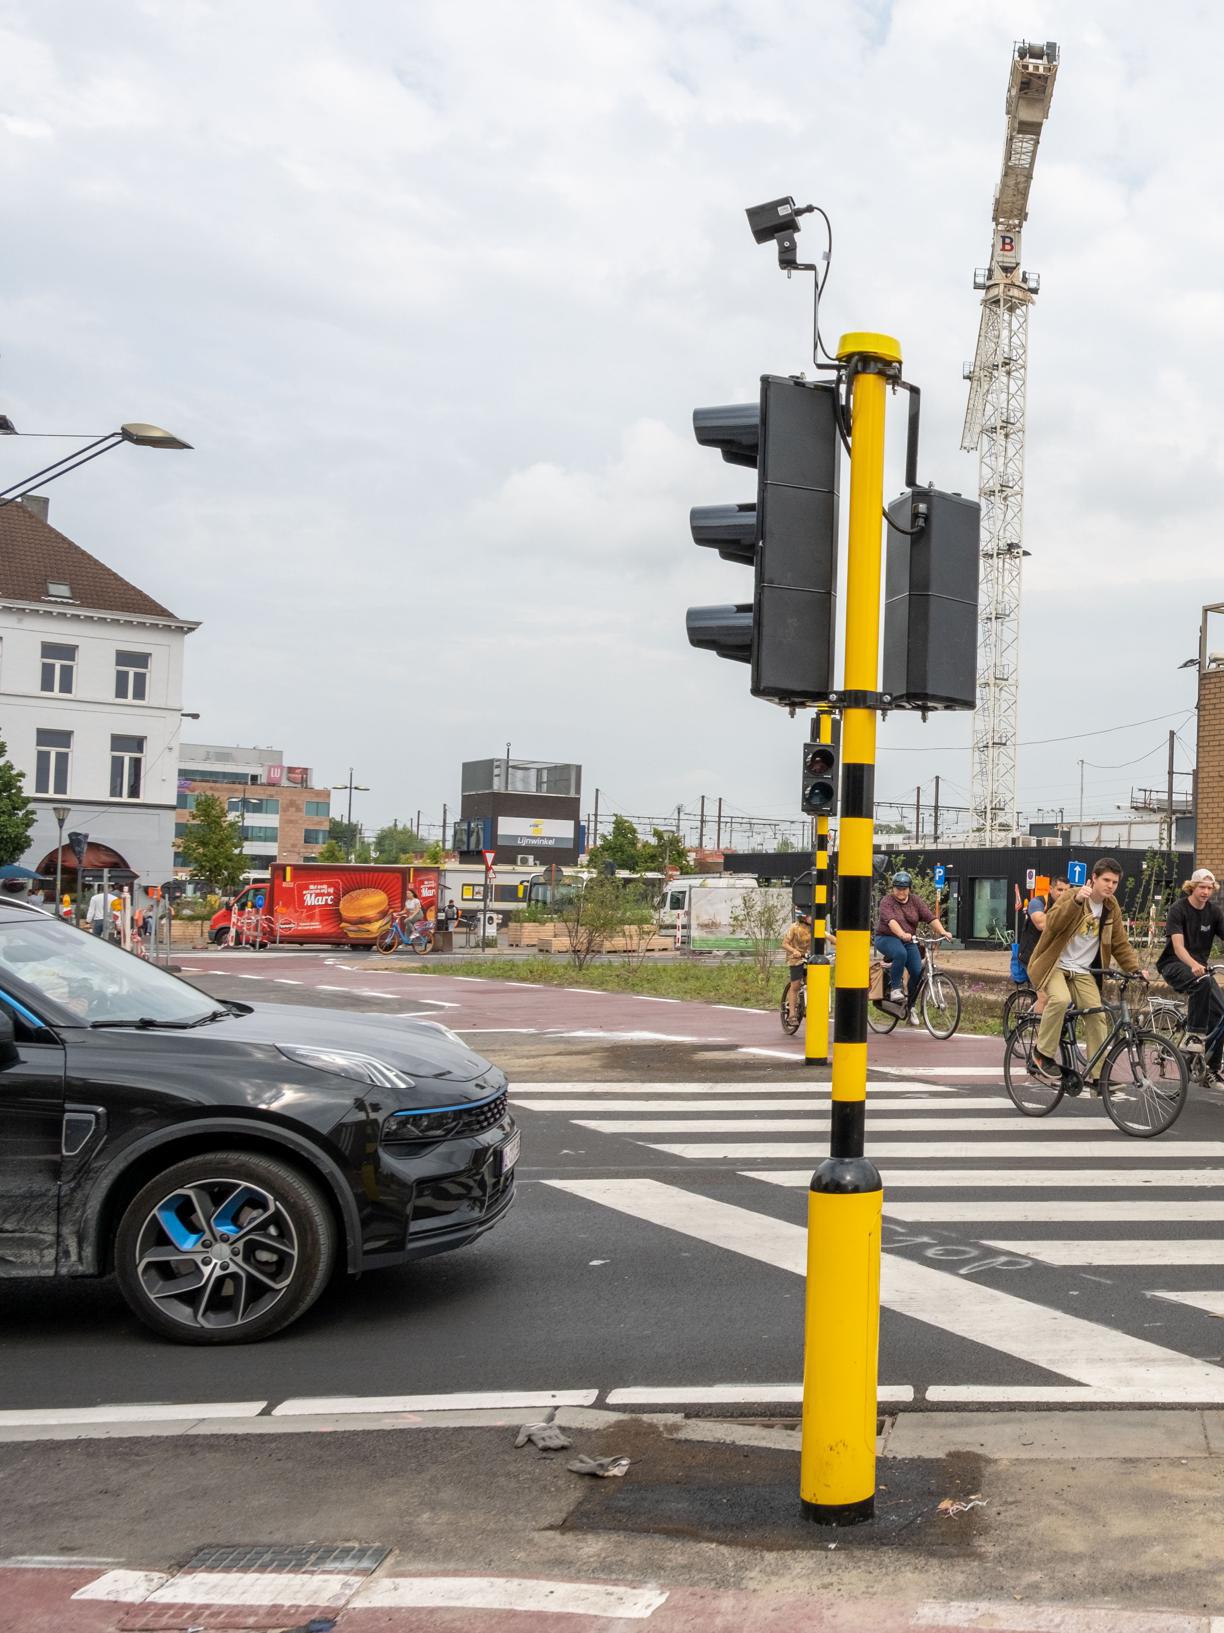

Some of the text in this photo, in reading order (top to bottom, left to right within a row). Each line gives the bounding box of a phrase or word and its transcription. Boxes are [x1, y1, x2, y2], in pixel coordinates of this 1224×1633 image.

[1000, 235, 1014, 252] B
[517, 836, 556, 847] Lijnwinkel
[935, 868, 944, 881] P
[420, 887, 436, 897] Mar
[303, 893, 335, 906] Marc
[881, 1223, 1034, 1275] TOP
